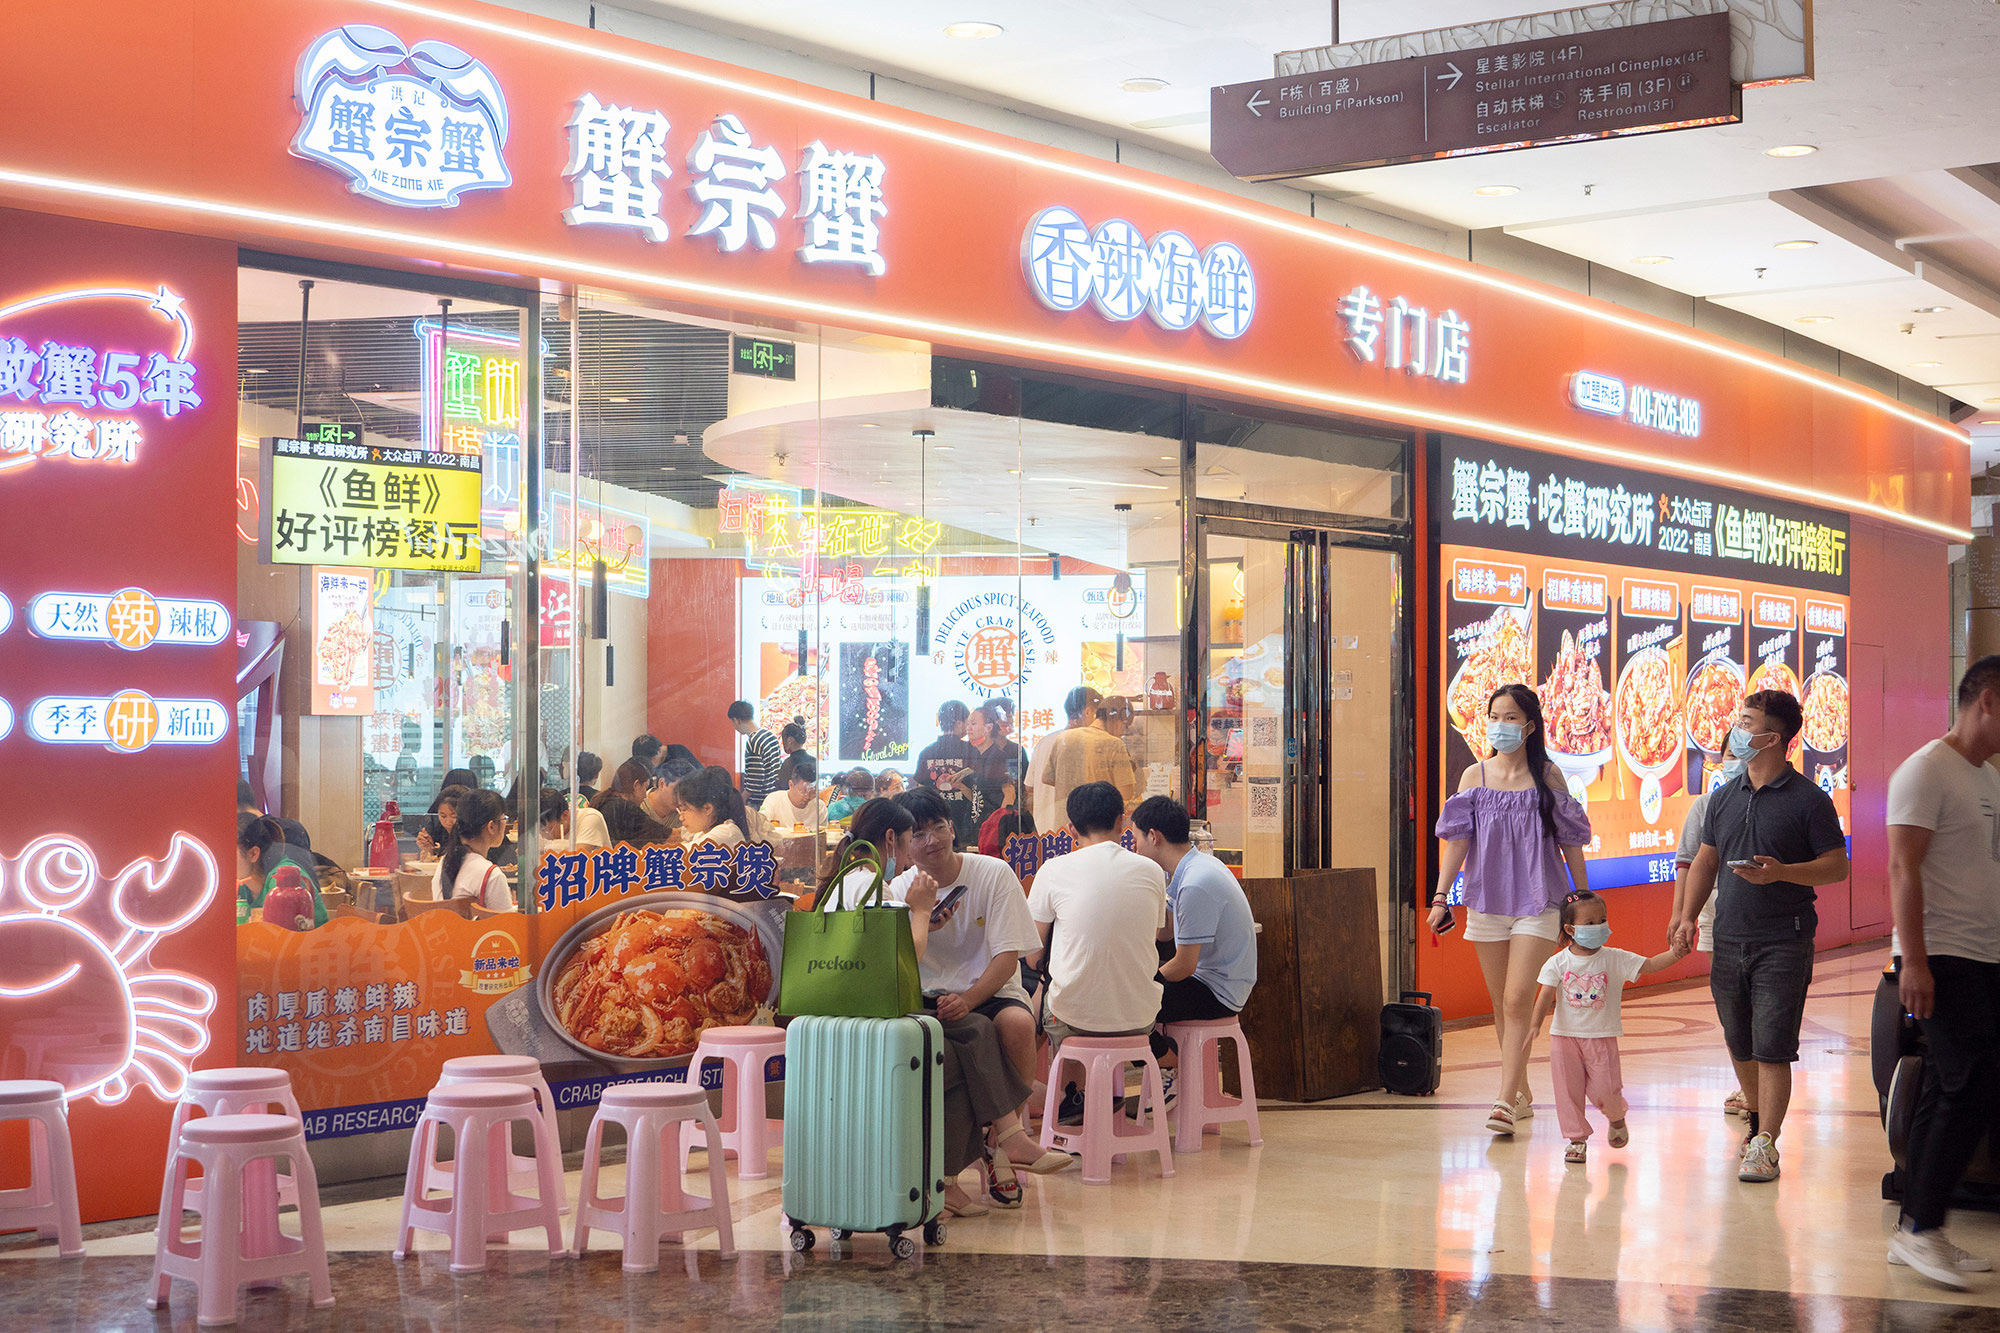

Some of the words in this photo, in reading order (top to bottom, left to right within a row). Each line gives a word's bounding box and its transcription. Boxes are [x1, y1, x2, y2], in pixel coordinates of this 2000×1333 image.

[1475, 78, 1520, 93] Stellar
[1523, 63, 1616, 86] International
[1279, 103, 1332, 118] Building
[1335, 91, 1404, 112] F(Parkson)
[1475, 93, 1545, 119] 自动扶梯
[1477, 118, 1541, 135] Escalator
[1577, 98, 1674, 121] Restroom(3F)
[328, 94, 486, 180] 蟹宗蟹
[370, 168, 389, 184] XIE
[391, 177, 423, 191] ZONG
[426, 178, 445, 192] XIE
[561, 91, 889, 276] 蟹宗蟹
[1033, 218, 1250, 336] 香辣海鲜
[1337, 285, 1471, 384] 专门店
[1629, 385, 1700, 438] 400-7626-808
[0, 410, 144, 463] 研究所
[382, 450, 423, 464] 大众点评
[427, 452, 481, 470] 2022·南昌
[319, 466, 441, 515] 《鱼鲜》
[1451, 457, 1655, 547] 蟹宗蟹·吃蟹研究所
[1671, 495, 1713, 528] 大众点评
[275, 508, 479, 560] 好评榜餐厅
[1658, 525, 1713, 557] 2022·南昌
[47, 601, 99, 633] 天然
[111, 593, 156, 646] 辣
[168, 606, 219, 638] 辣椒
[935, 594, 983, 645] DELICIOUS
[983, 592, 1018, 609] SPICY
[975, 615, 1014, 630] CRAB
[953, 629, 992, 699] INSTITUTE
[973, 633, 1021, 682] 蟹
[46, 703, 97, 736] 季季
[110, 698, 154, 747] 研
[167, 706, 214, 737] 新品
[538, 842, 780, 912] 招牌蟹宗煲
[473, 955, 520, 972] 新品来啦
[247, 980, 421, 1022] 肉厚质嫩鲜辣
[245, 1006, 471, 1054] 地道绝杀南昌味道
[560, 1082, 602, 1104] CRAB
